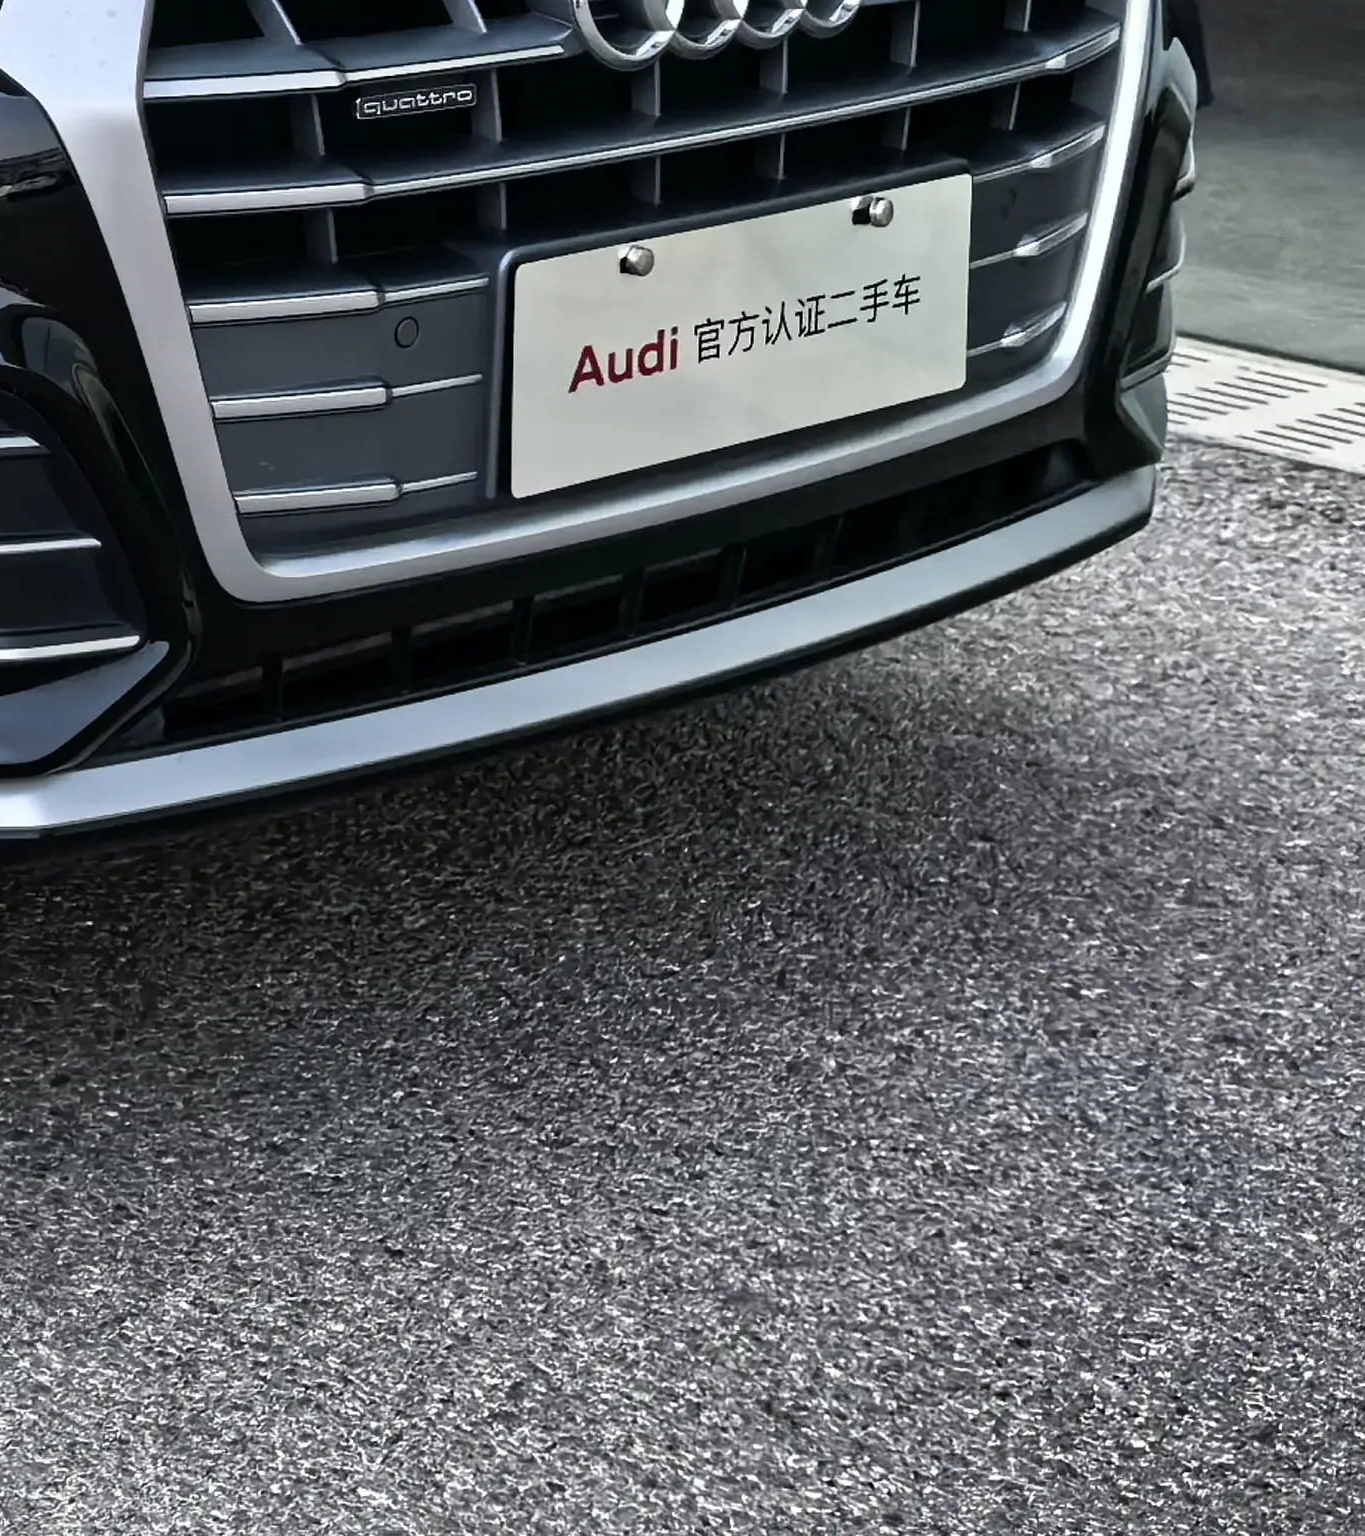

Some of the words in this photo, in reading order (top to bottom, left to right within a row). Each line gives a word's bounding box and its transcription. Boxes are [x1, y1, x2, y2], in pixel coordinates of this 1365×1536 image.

[362, 89, 473, 115] quattro
[568, 327, 679, 394] Audi
[693, 273, 922, 364] 官方认证二手车
